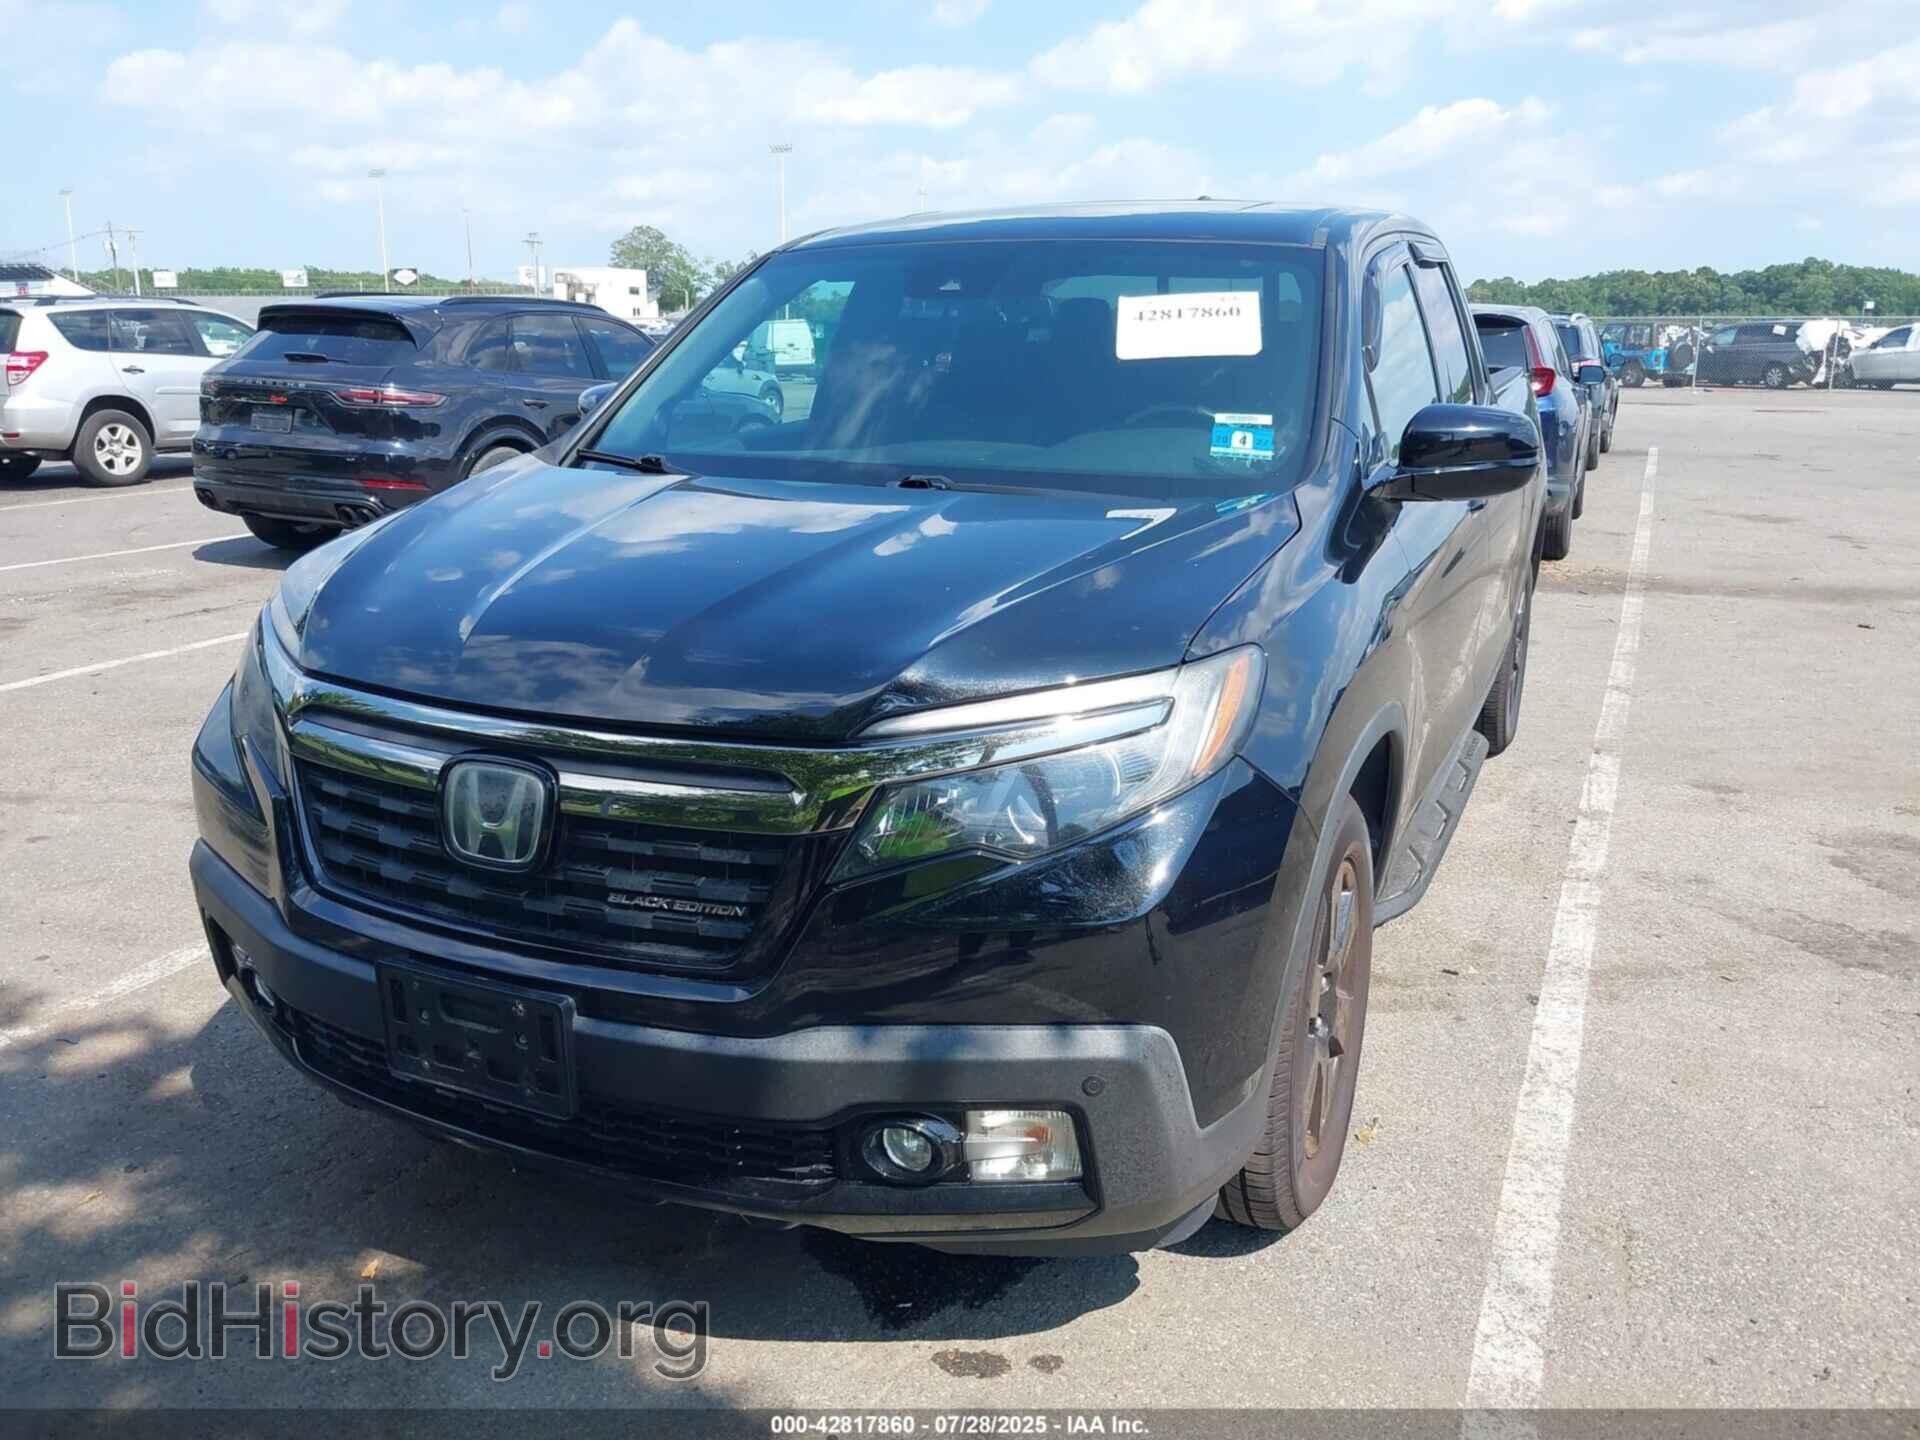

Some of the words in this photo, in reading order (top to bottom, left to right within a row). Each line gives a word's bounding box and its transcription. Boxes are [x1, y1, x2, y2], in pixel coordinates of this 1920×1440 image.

[1133, 306, 1241, 323] 42817860
[1239, 431, 1247, 446] 4
[608, 892, 669, 910] BLACK
[672, 899, 747, 917] EDITION
